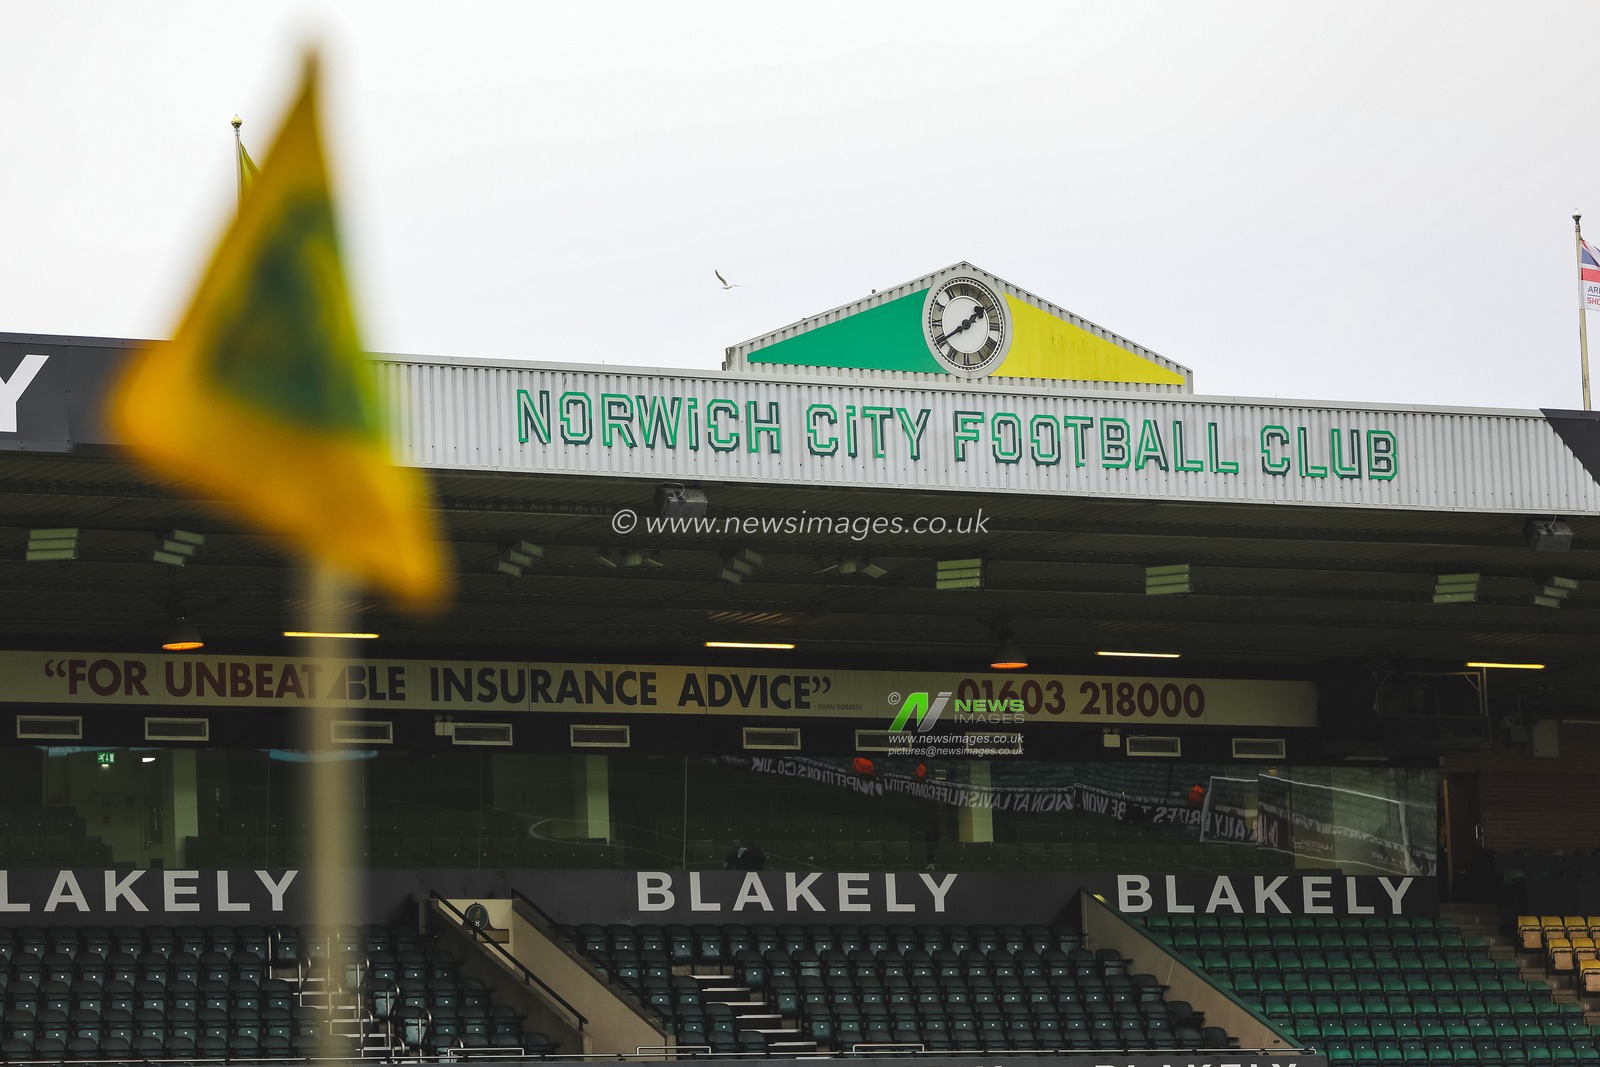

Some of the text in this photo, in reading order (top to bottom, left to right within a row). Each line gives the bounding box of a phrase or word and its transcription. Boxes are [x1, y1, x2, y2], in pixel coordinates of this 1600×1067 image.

[954, 410, 1239, 474] FOOTBALL
[1260, 424, 1397, 481] CLUB
[430, 667, 657, 706] INSURANCE
[1079, 682, 1205, 718] 218000
[636, 871, 958, 912] BLAKELY
[1116, 874, 1415, 915] BLAKELY
